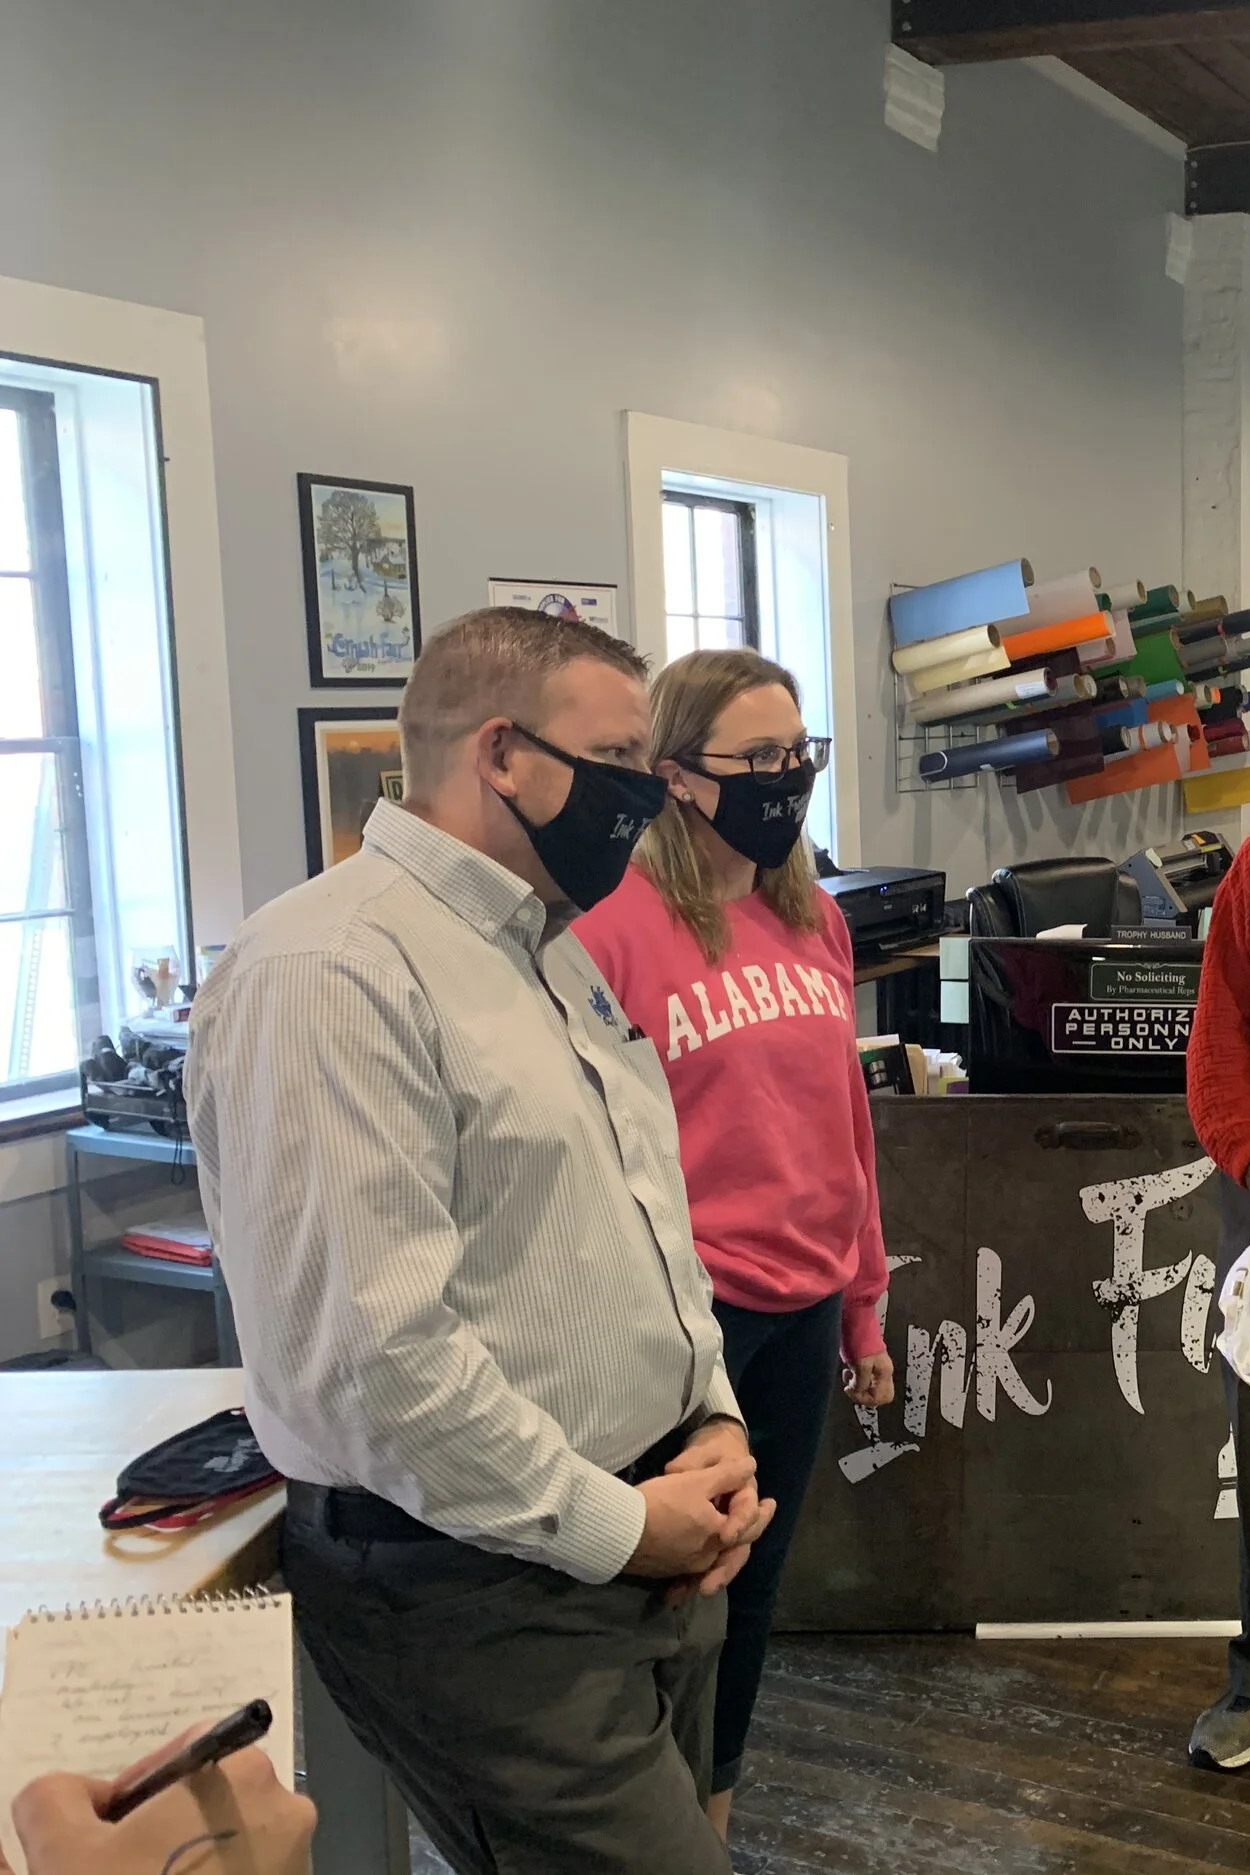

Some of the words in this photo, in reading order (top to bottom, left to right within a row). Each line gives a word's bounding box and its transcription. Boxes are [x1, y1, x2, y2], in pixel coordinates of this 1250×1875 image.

[762, 802, 784, 821] Ink
[609, 813, 635, 840] Ink
[1117, 931, 1148, 939] TROPHY
[1150, 930, 1187, 940] HUSBAND
[1116, 971, 1132, 982] No
[1134, 971, 1186, 986] Soliciting
[1106, 984, 1116, 995] By
[1118, 985, 1175, 995] Pharmaceutical
[1177, 985, 1196, 997] Reps
[1068, 1008, 1190, 1022] AUTHORIZ
[1066, 1023, 1189, 1036] PERSONN
[1111, 1037, 1179, 1050] ONLY
